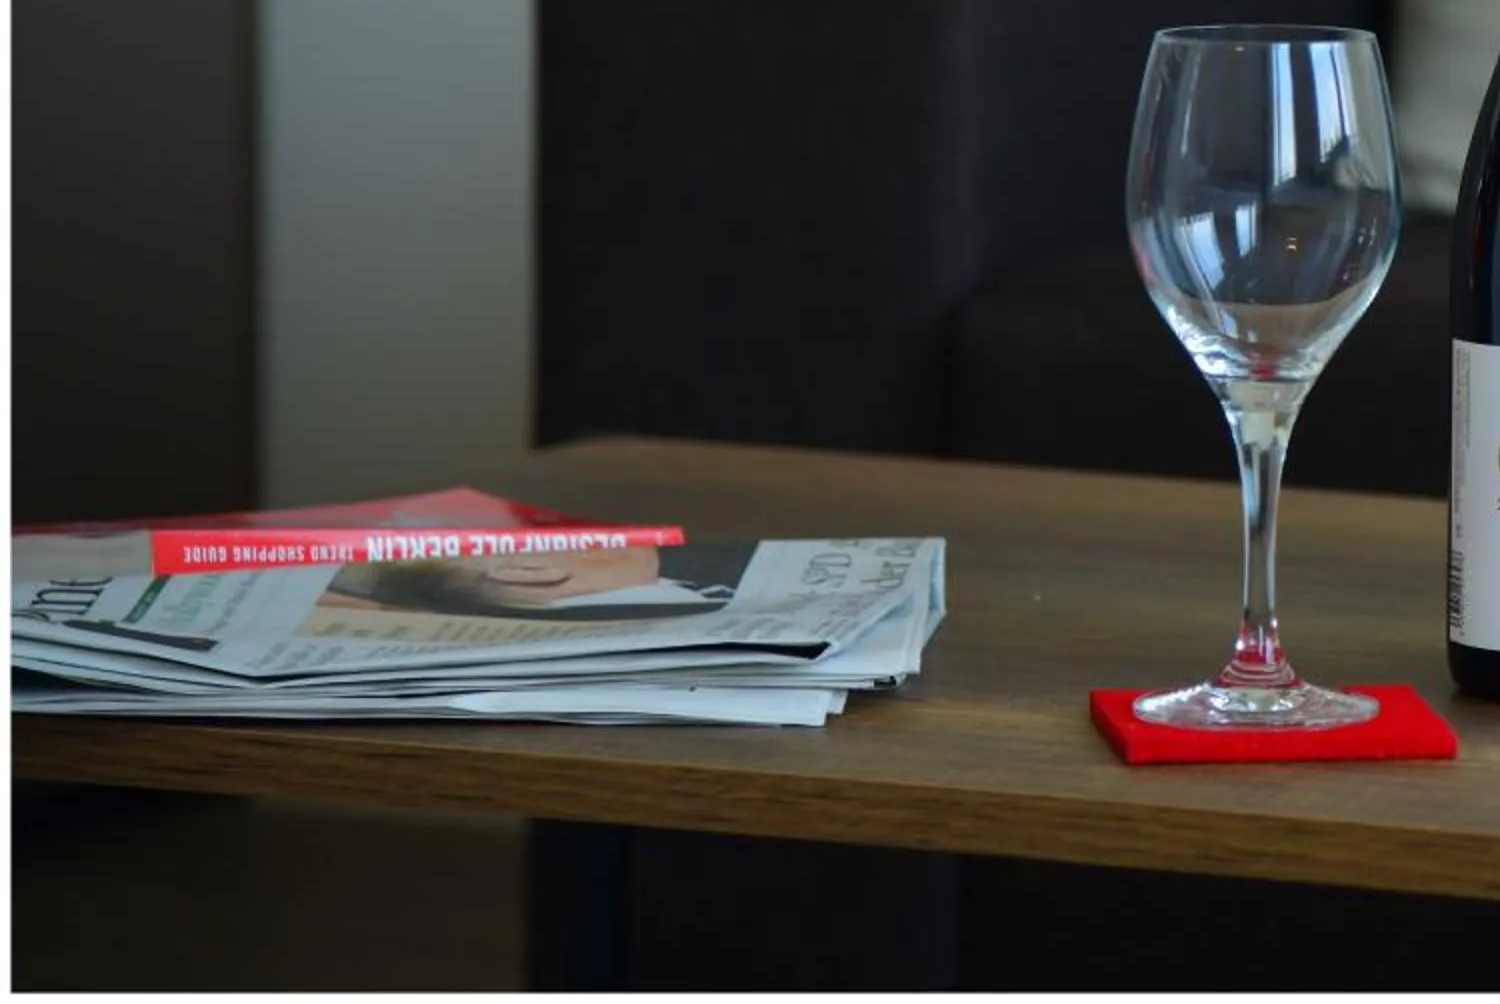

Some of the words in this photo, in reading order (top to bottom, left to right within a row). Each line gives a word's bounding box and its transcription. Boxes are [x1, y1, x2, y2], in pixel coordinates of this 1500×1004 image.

[183, 546, 226, 564] GUIDE
[233, 545, 305, 563] SHOPPING
[310, 544, 354, 562] TREND
